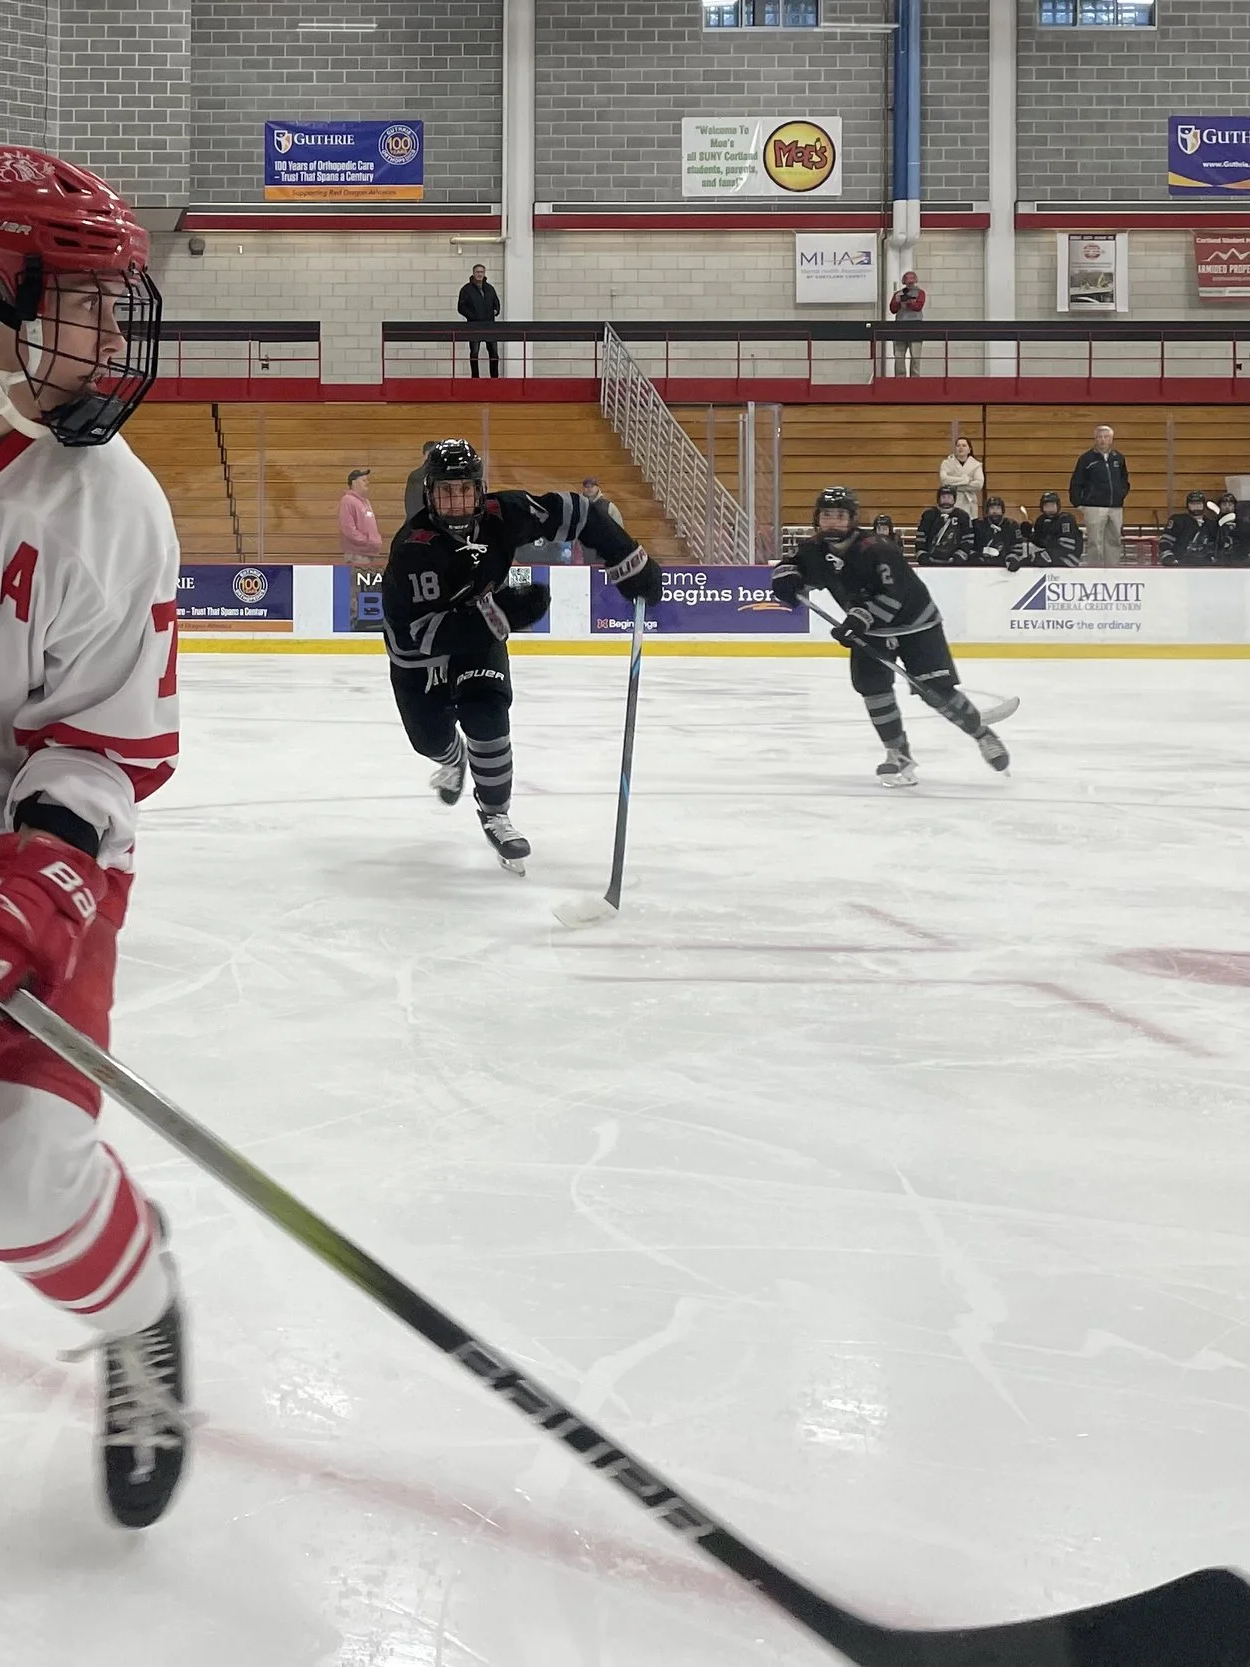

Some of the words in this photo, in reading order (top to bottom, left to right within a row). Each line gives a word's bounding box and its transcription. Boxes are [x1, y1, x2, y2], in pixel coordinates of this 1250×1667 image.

[738, 126, 750, 134] To
[294, 133, 355, 145] GUTHRIE
[388, 136, 411, 148] 100
[686, 152, 698, 161] all
[699, 152, 722, 161] SUNY
[724, 152, 758, 161] Cortland
[274, 161, 286, 170] 100
[288, 161, 307, 170] Years
[309, 161, 316, 170] of
[318, 161, 356, 172] Orthopedic
[358, 161, 374, 170] Care
[281, 172, 298, 182] Trust
[300, 172, 316, 182] That
[317, 172, 339, 182] Spans
[346, 172, 374, 182] Century
[702, 178, 718, 187] and
[0, 541, 38, 622] A
[408, 571, 440, 604] 18
[1048, 583, 1145, 601] SUMMIT
[191, 607, 206, 616] Trust
[207, 607, 220, 616] That
[221, 607, 239, 616] Spans
[244, 607, 268, 617] Century
[1010, 620, 1074, 630] ELEVATING
[1076, 620, 1094, 629] the
[1097, 620, 1141, 631] ordinary
